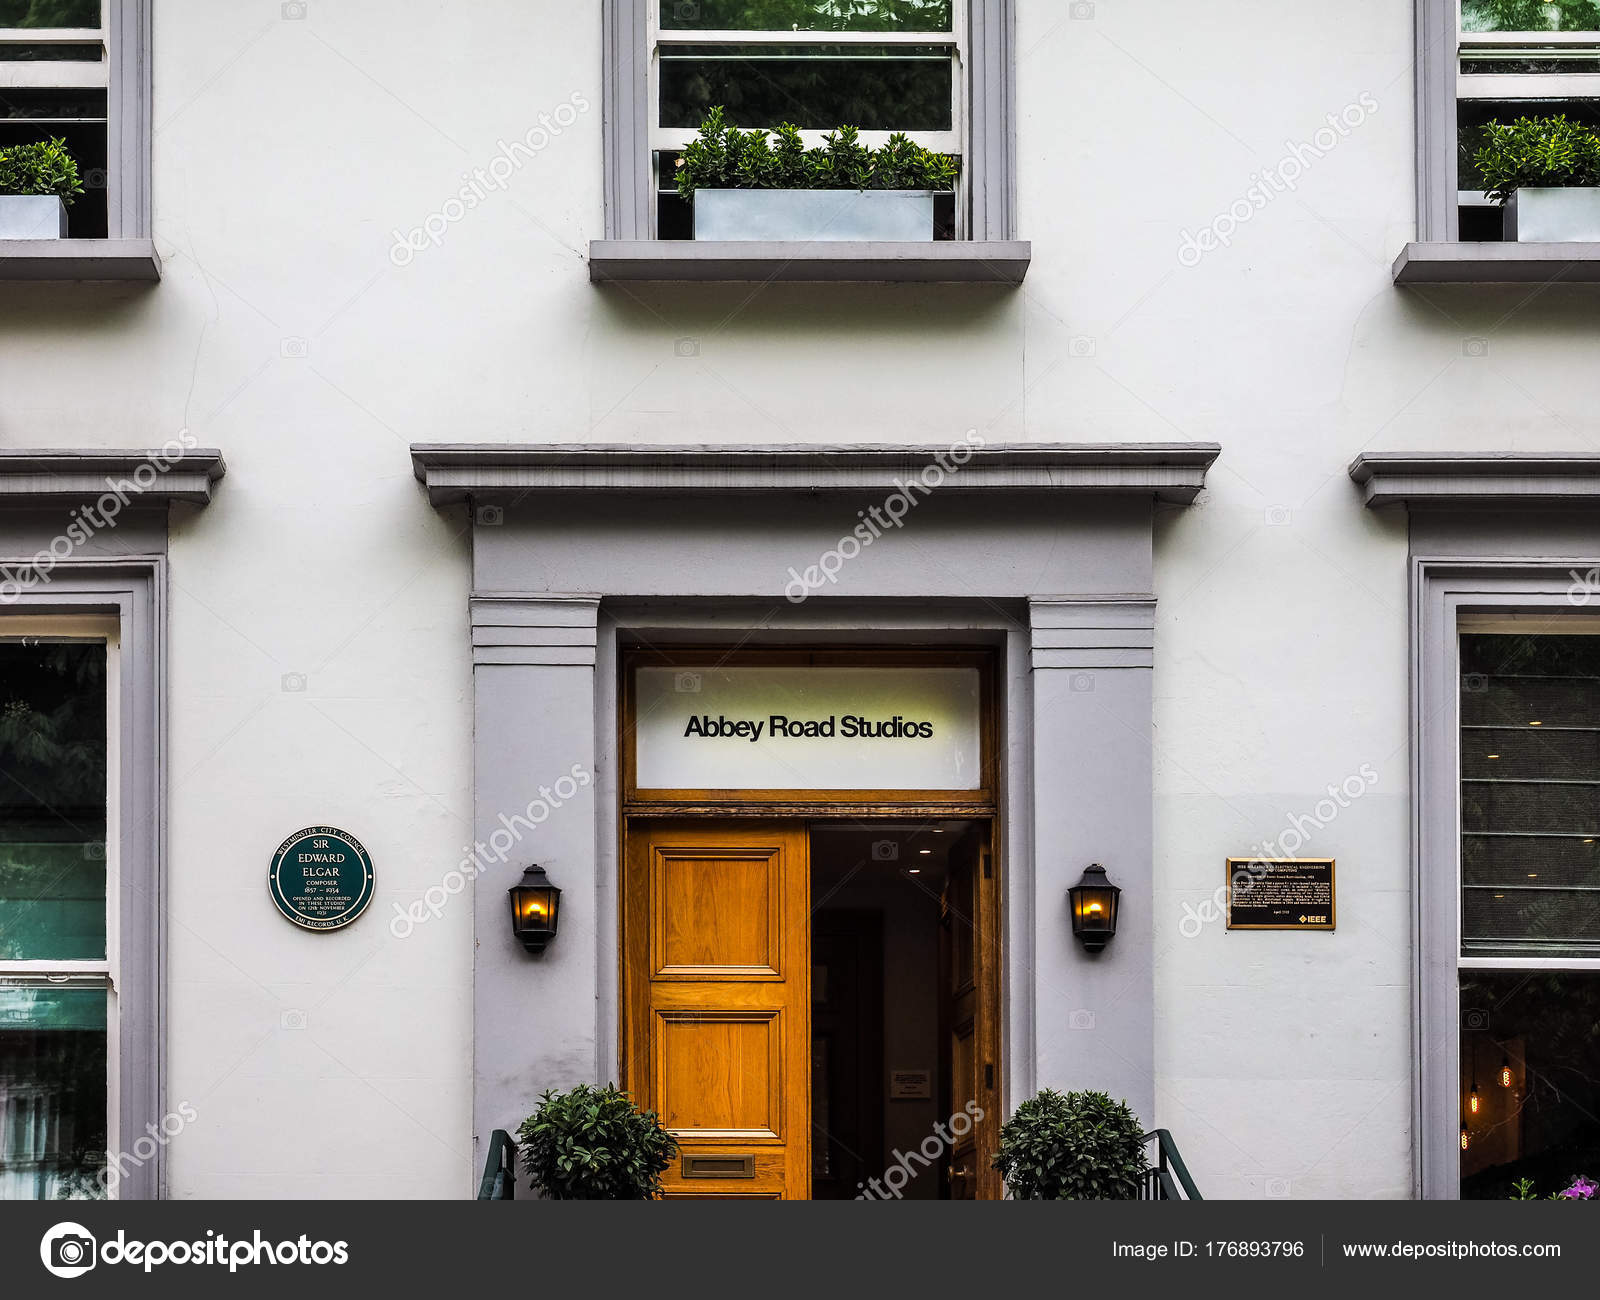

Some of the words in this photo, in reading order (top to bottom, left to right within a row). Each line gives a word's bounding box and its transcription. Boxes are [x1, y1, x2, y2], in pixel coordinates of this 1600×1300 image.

[683, 715, 765, 742] Abbey
[769, 715, 835, 738] Road
[840, 715, 933, 738] Studios
[277, 828, 317, 856] WESTMINSTER
[320, 827, 338, 835] CITY
[340, 832, 366, 856] COUNCIL
[313, 840, 329, 848] SIR
[298, 853, 345, 863] EDWARD
[303, 867, 340, 877] ELGAR
[1307, 915, 1327, 923] IEEE
